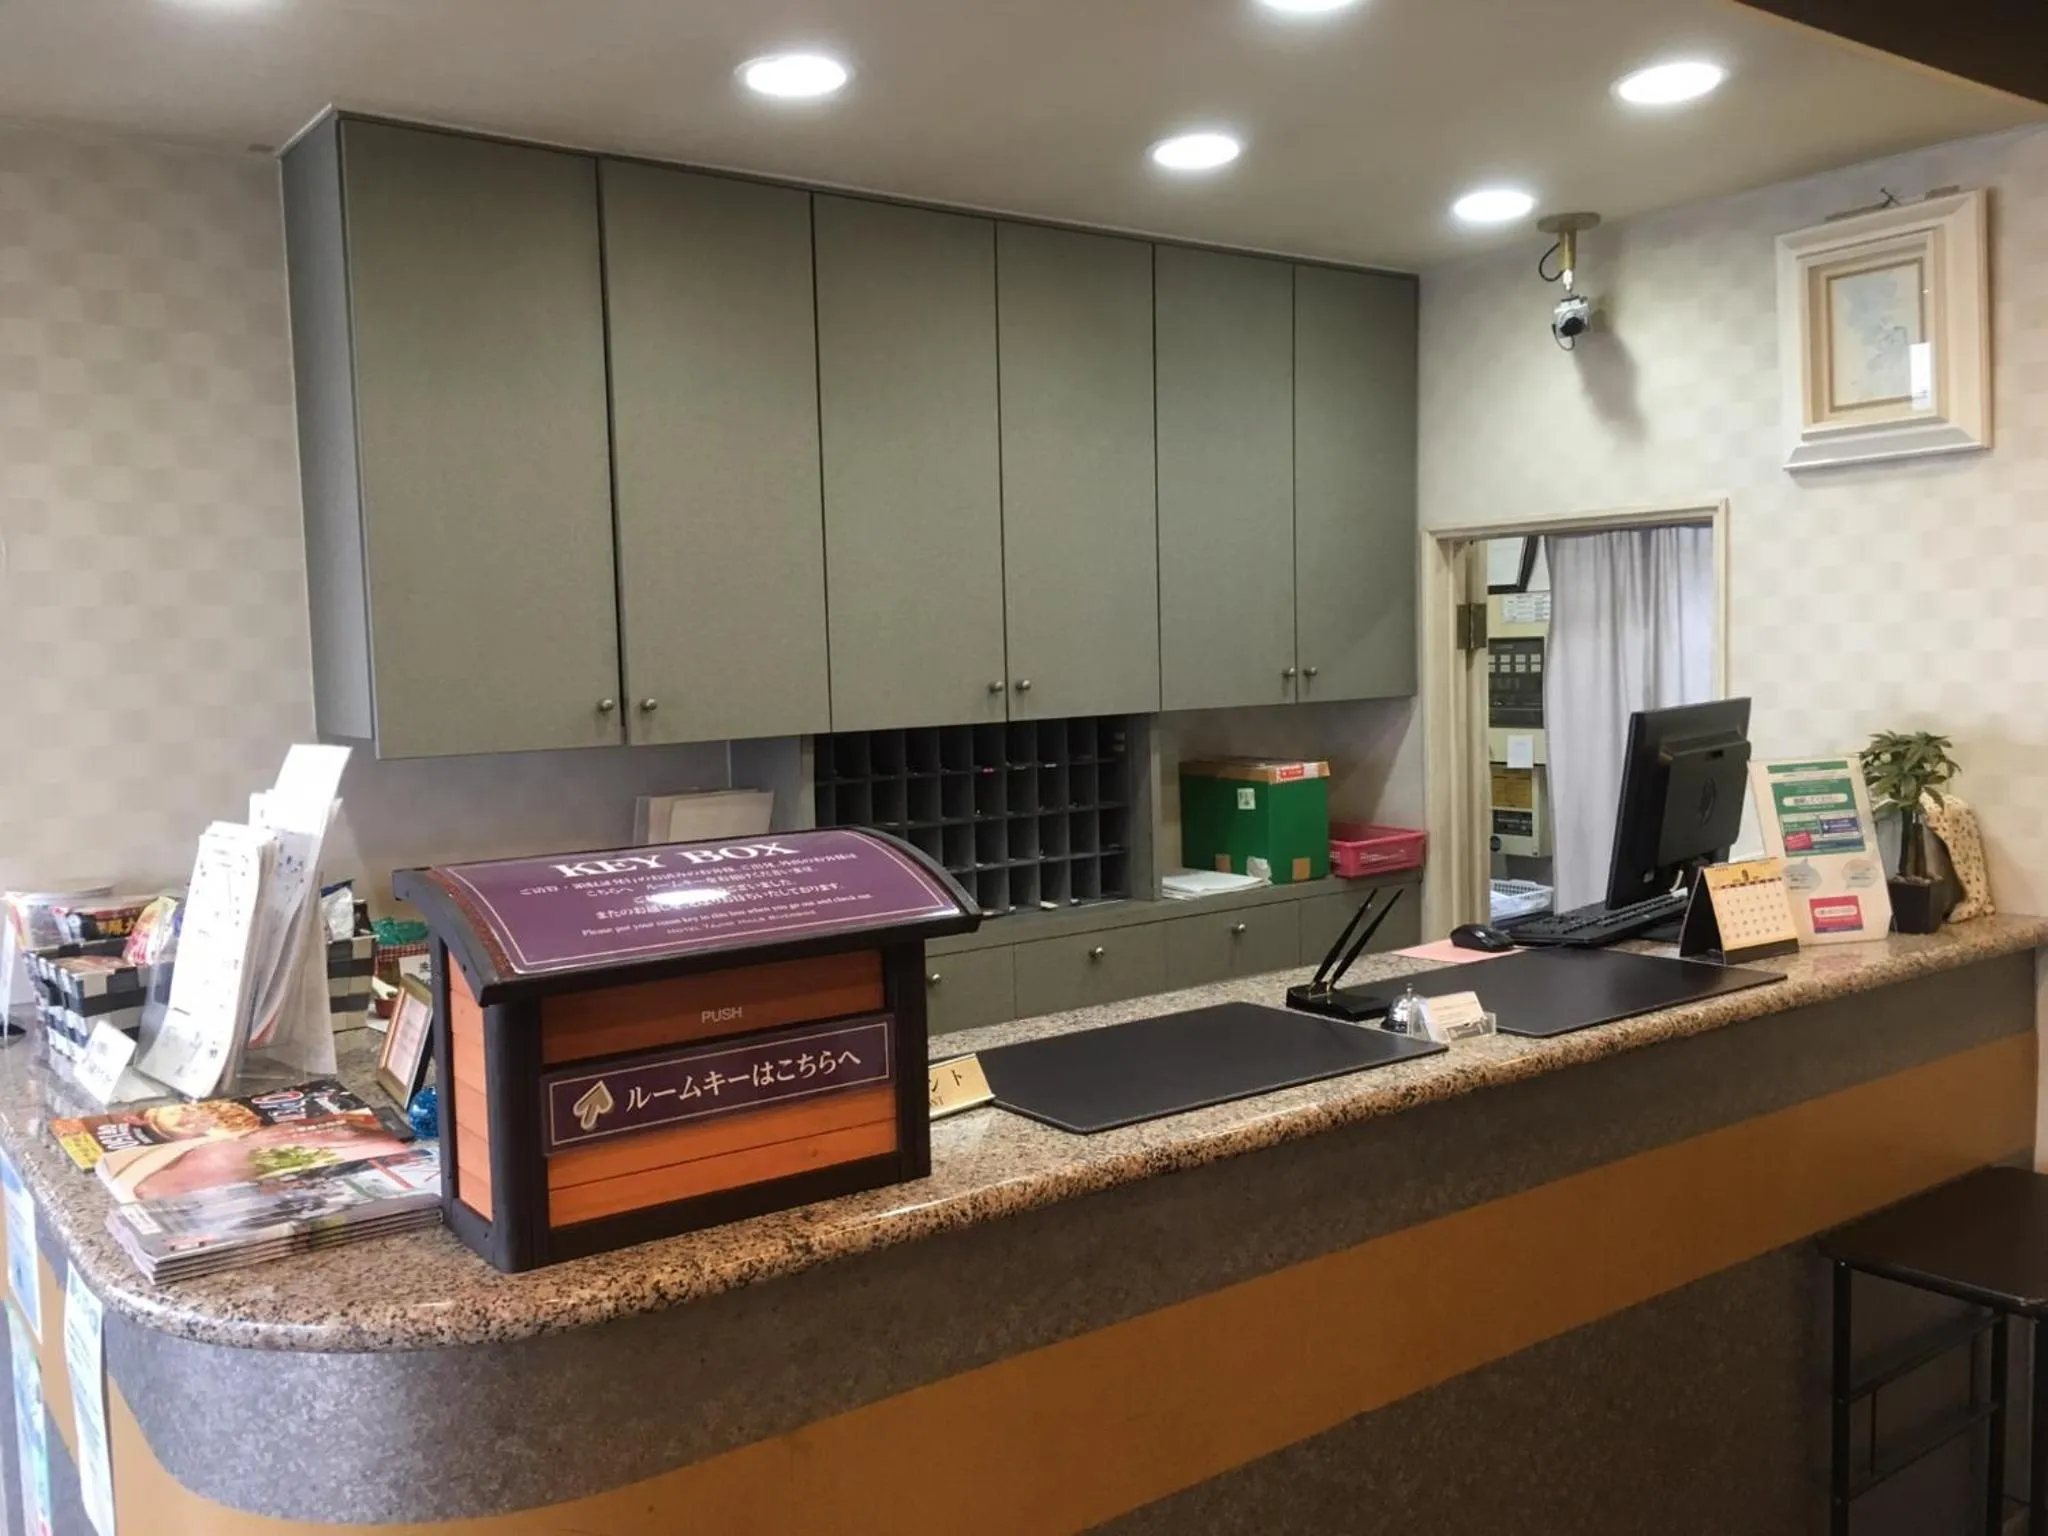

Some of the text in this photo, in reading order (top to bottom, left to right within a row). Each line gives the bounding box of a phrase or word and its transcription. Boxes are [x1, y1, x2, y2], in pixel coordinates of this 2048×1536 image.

[550, 855, 667, 878] KEY
[677, 842, 800, 864] BOX
[701, 1006, 743, 1023] PUSH
[626, 1050, 861, 1113] ルームキーはこちらへ
